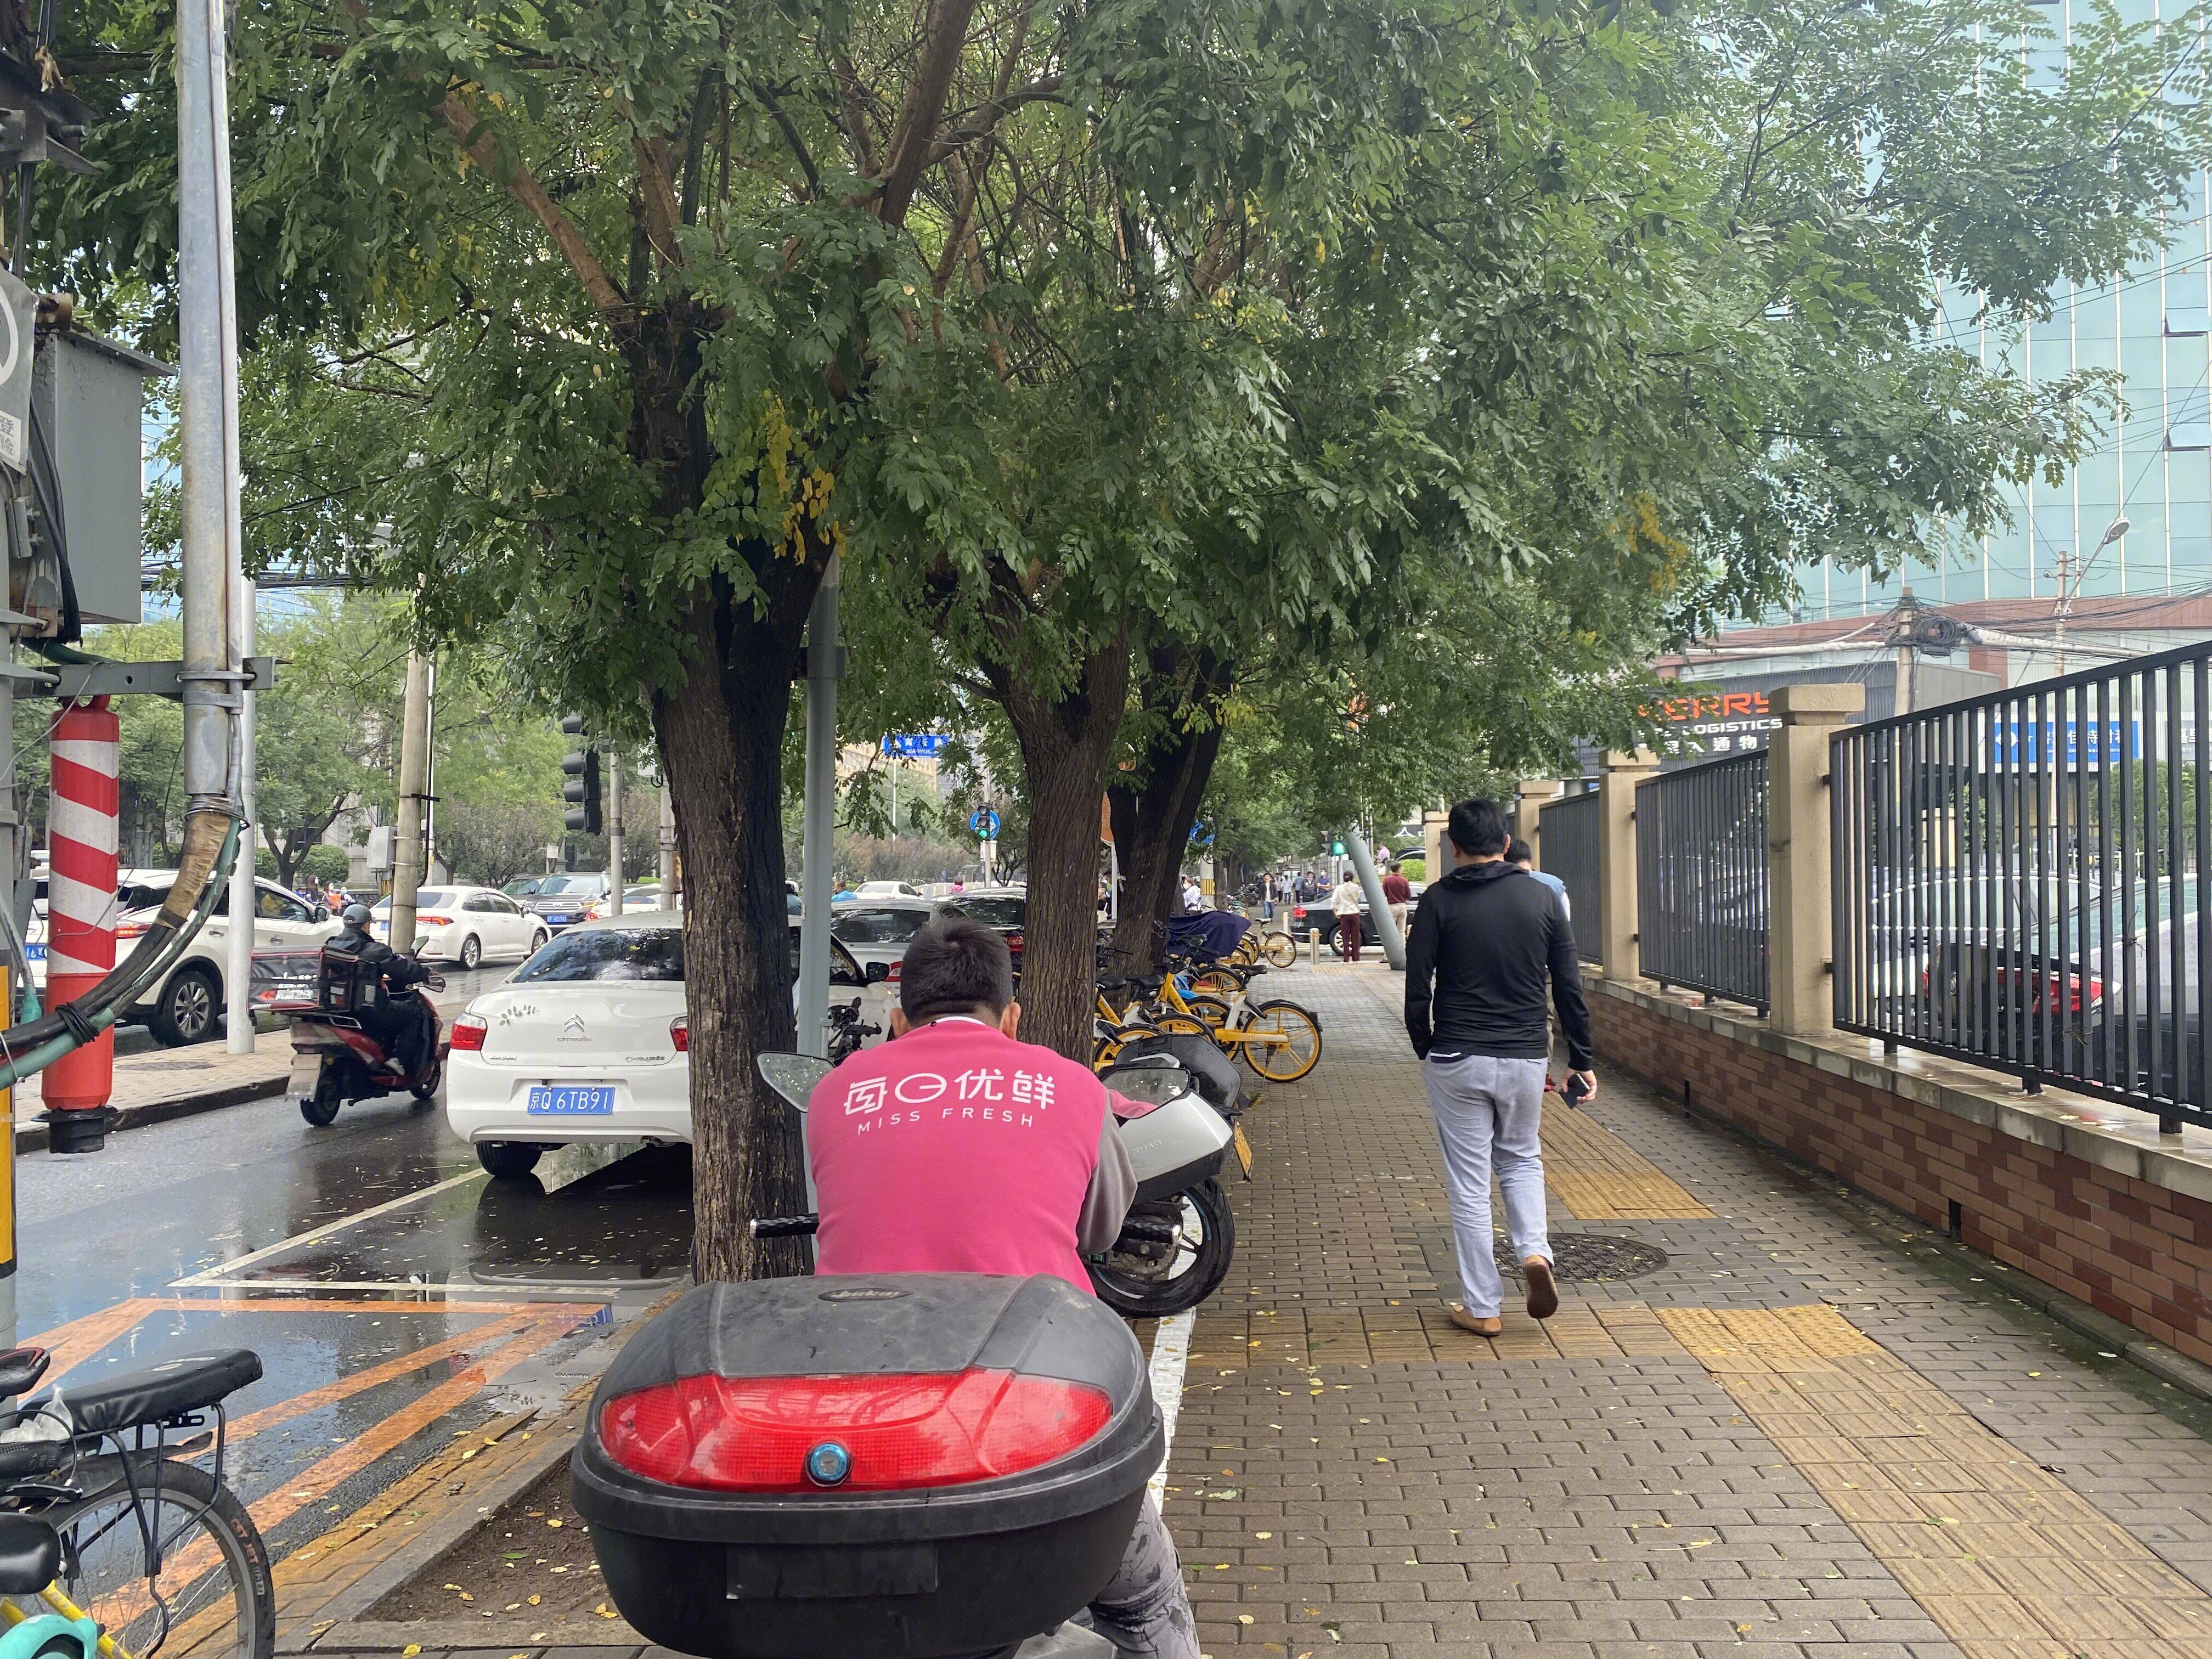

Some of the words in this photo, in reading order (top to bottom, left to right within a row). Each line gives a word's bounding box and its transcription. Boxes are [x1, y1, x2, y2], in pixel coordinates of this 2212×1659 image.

[843, 1068, 1056, 1115] 每日优鲜
[857, 1110, 921, 1136] MISS
[941, 1107, 1034, 1128] FRESH
